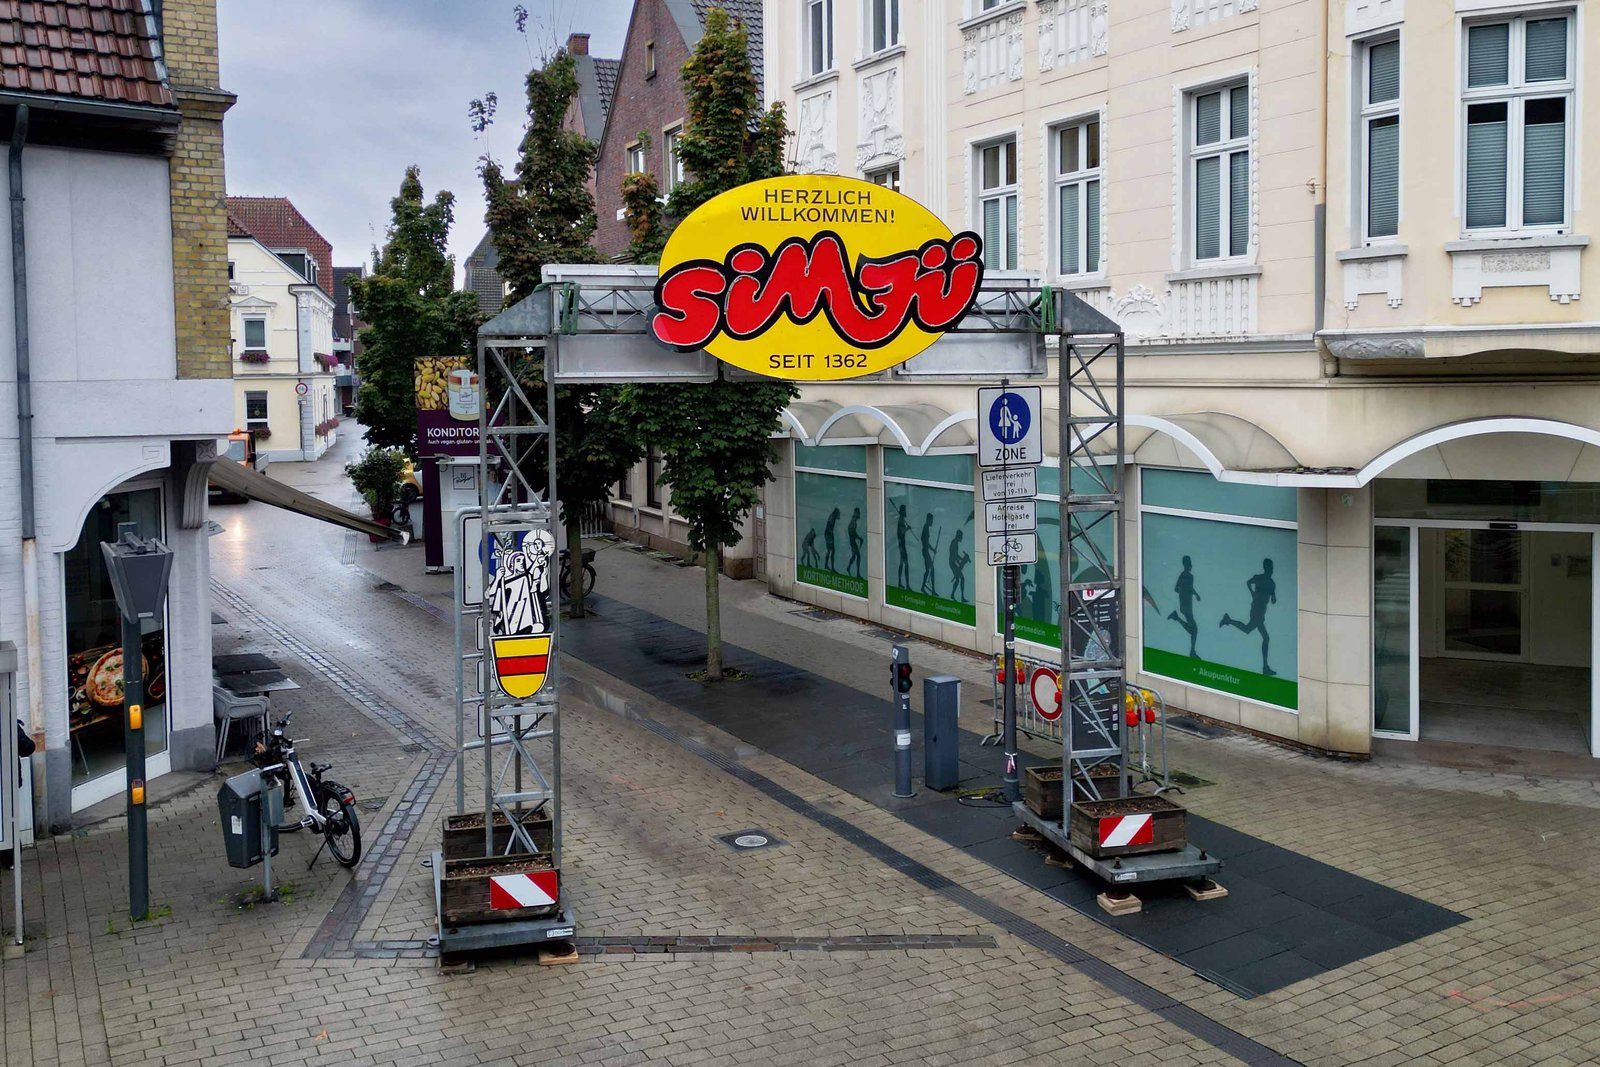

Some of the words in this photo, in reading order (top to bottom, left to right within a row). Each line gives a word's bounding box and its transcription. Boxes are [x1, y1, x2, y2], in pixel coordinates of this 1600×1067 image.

[764, 189, 872, 206] HERZLICH
[741, 206, 895, 224] WILLKOMMEN!
[769, 353, 816, 369] SEIT
[823, 353, 868, 369] 1362
[427, 427, 480, 438] KONDITOR
[995, 447, 1027, 461] ZONE
[986, 471, 1031, 481] Lieferverkehr
[997, 504, 1025, 512] Anreise
[1014, 624, 1047, 637] portmedizin
[1199, 668, 1240, 685] Akupunktur
